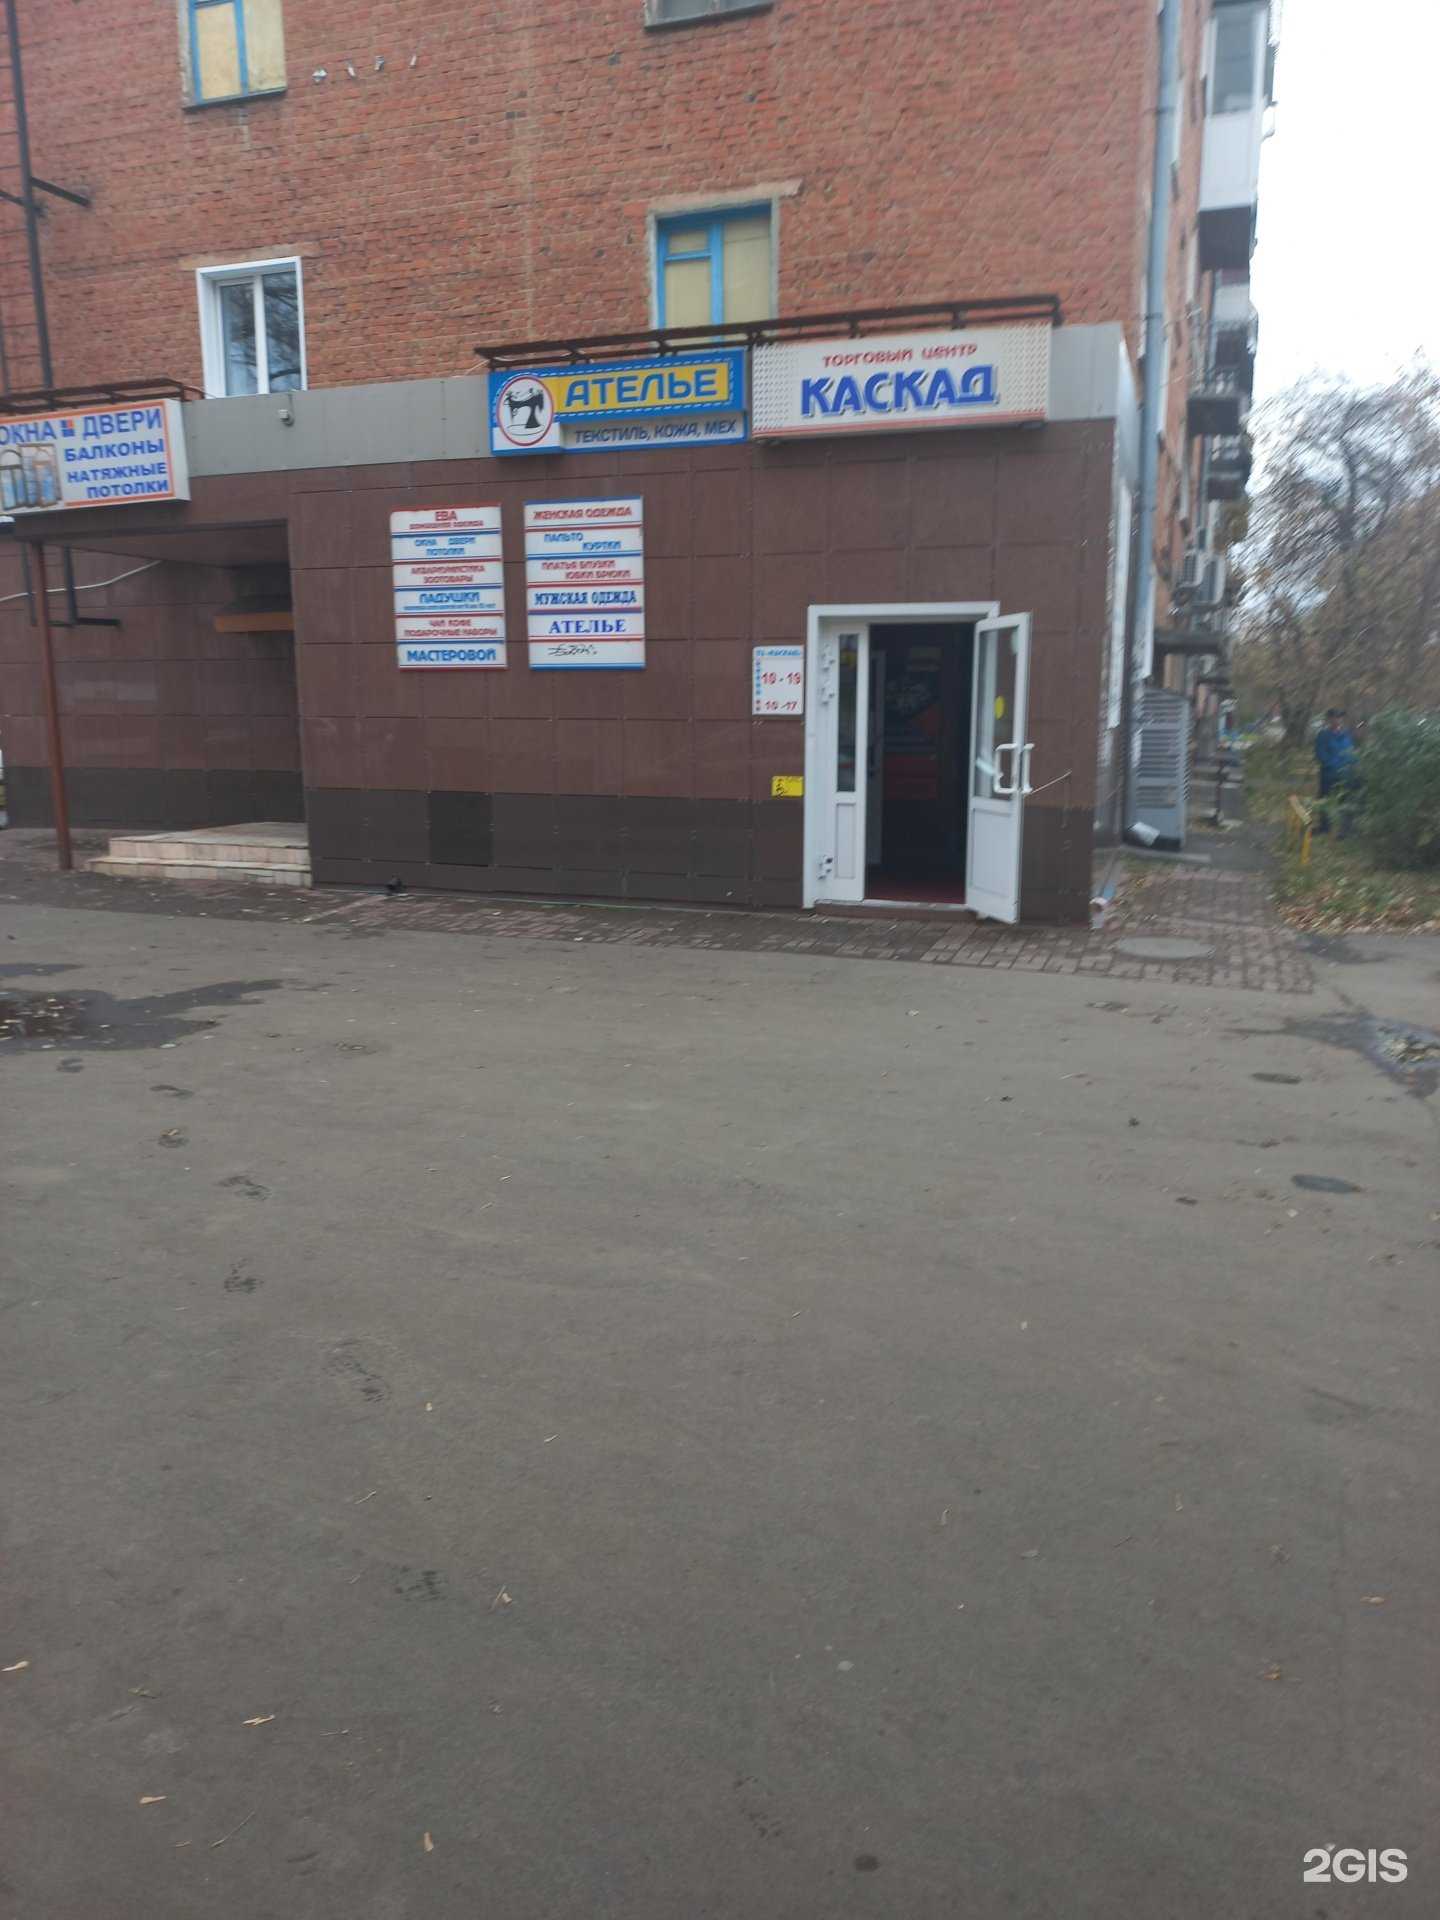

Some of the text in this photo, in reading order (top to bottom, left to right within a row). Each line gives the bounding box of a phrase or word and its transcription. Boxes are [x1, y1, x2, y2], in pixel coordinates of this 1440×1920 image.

[823, 343, 977, 367] ТОРГОВЫЙ ЦЕНТР
[565, 369, 717, 407] АТЕЛЬЕ
[801, 364, 998, 417] КАСКАД
[0, 408, 162, 446] ОКНА ДВЕРИ
[575, 419, 737, 444] ТЕКСТИЛЬ, КОЖА, МЕХ
[64, 438, 165, 463] БАЛКОНЫ
[67, 462, 167, 484] НАТЯЖНЫЕ
[86, 480, 169, 499] ПОТОЛКИ
[533, 506, 632, 521] ЖЕНСКАЯ ОДЕЖДА
[544, 532, 583, 543] ПАЛЬТО
[582, 540, 622, 551] КУРТКИ
[419, 591, 480, 604] ПАДУШКИ
[534, 590, 637, 606] МУЖСКАЯ ОДЕЖДА
[548, 619, 626, 634] АТЕЛЬЕ
[407, 648, 496, 662] МАСТЕРОВОЙ
